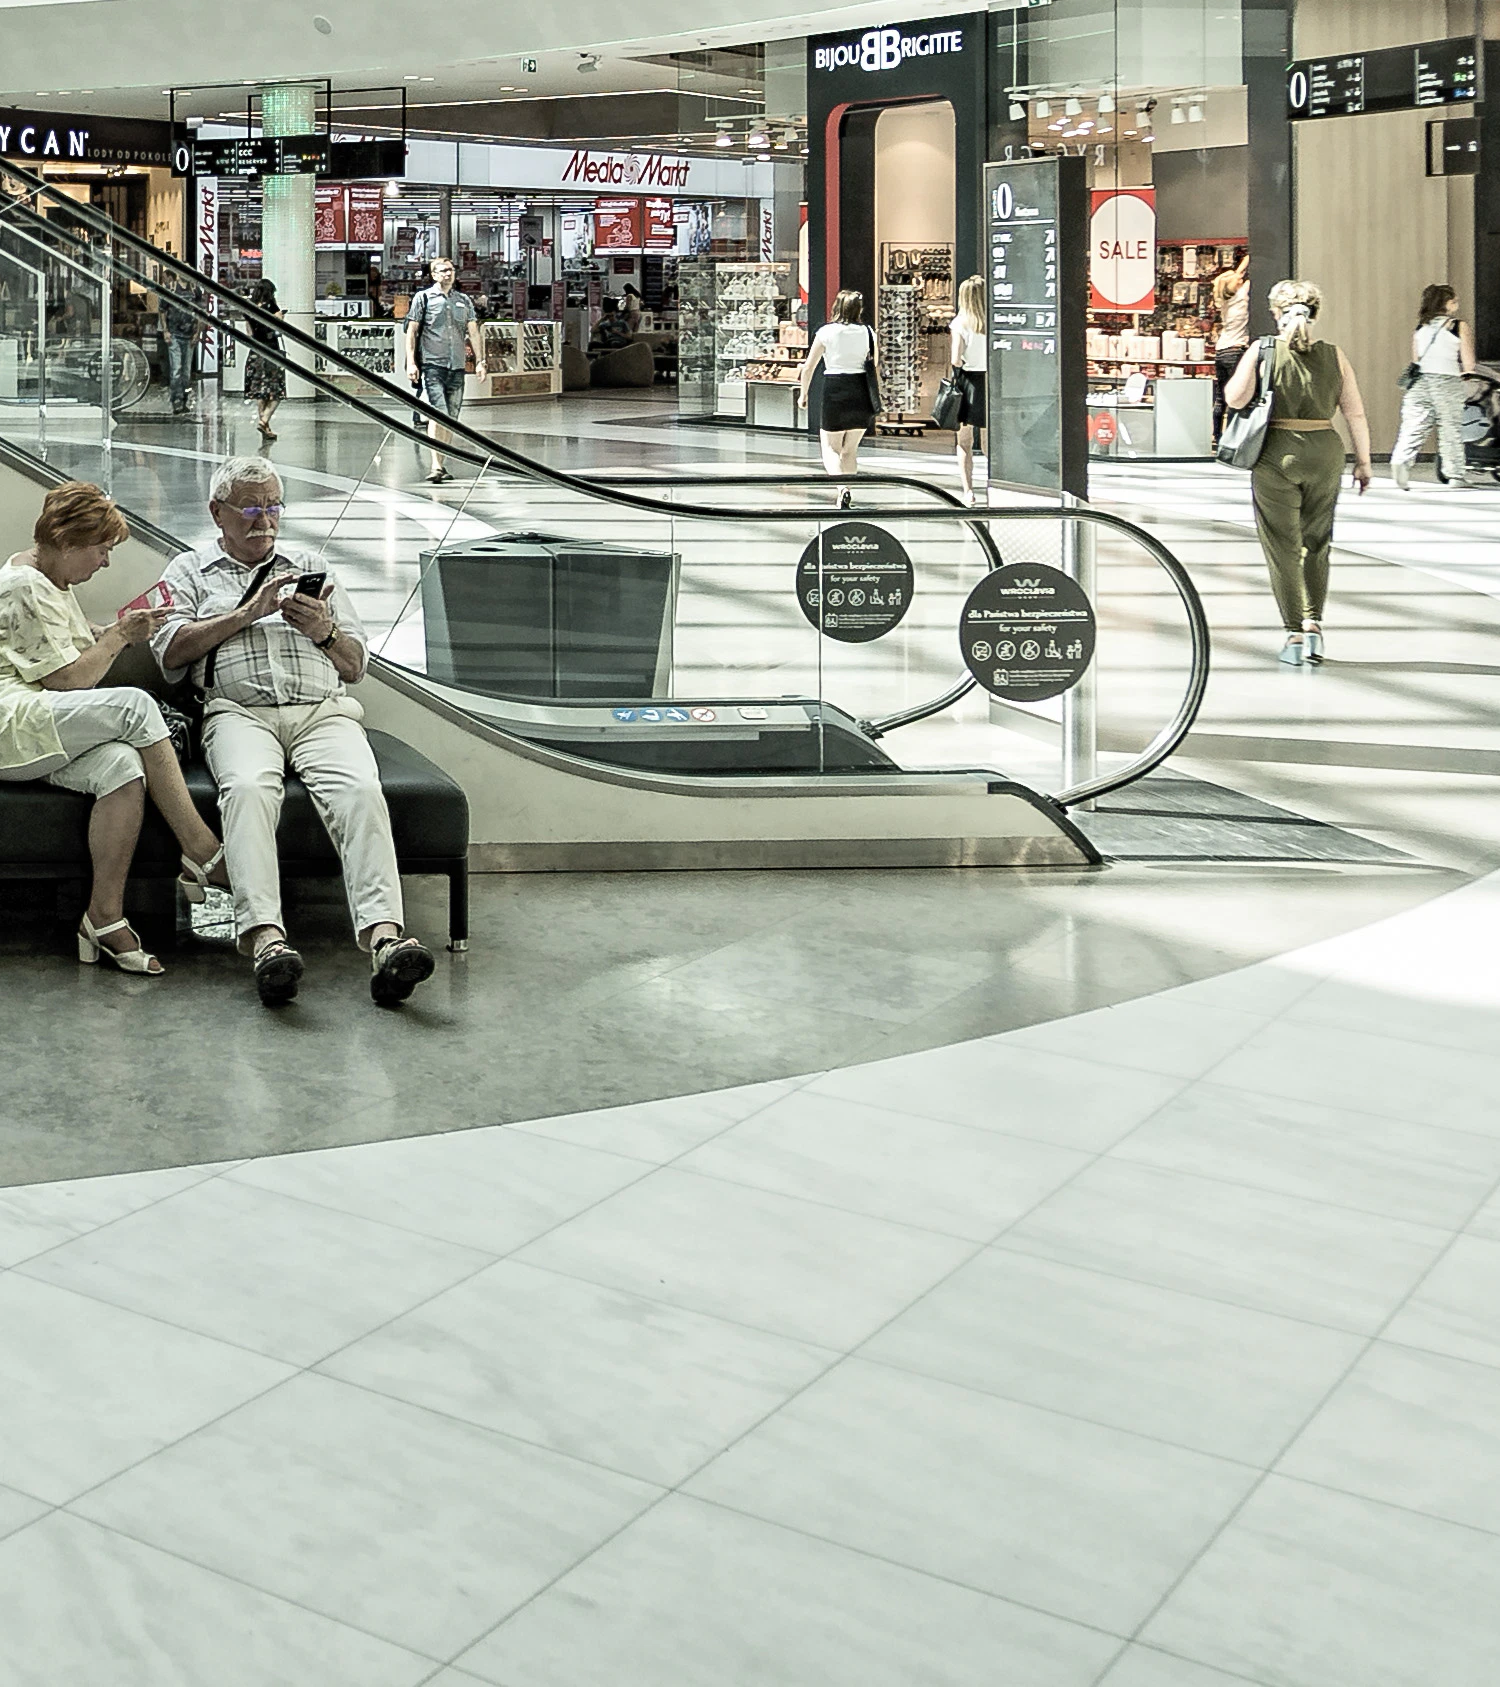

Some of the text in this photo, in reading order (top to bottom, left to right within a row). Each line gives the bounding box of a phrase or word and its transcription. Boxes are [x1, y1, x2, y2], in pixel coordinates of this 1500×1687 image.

[815, 44, 860, 71] BIJOU
[1290, 72, 1307, 108] 0
[117, 150, 130, 160] OD
[176, 148, 189, 171] 0
[561, 150, 691, 187] Media Markt
[997, 182, 1013, 220] 0
[762, 208, 772, 263] Markt
[1099, 240, 1148, 260] SALE
[830, 574, 880, 584] for your safety
[968, 610, 982, 619] dla
[999, 623, 1058, 635] for your safety
